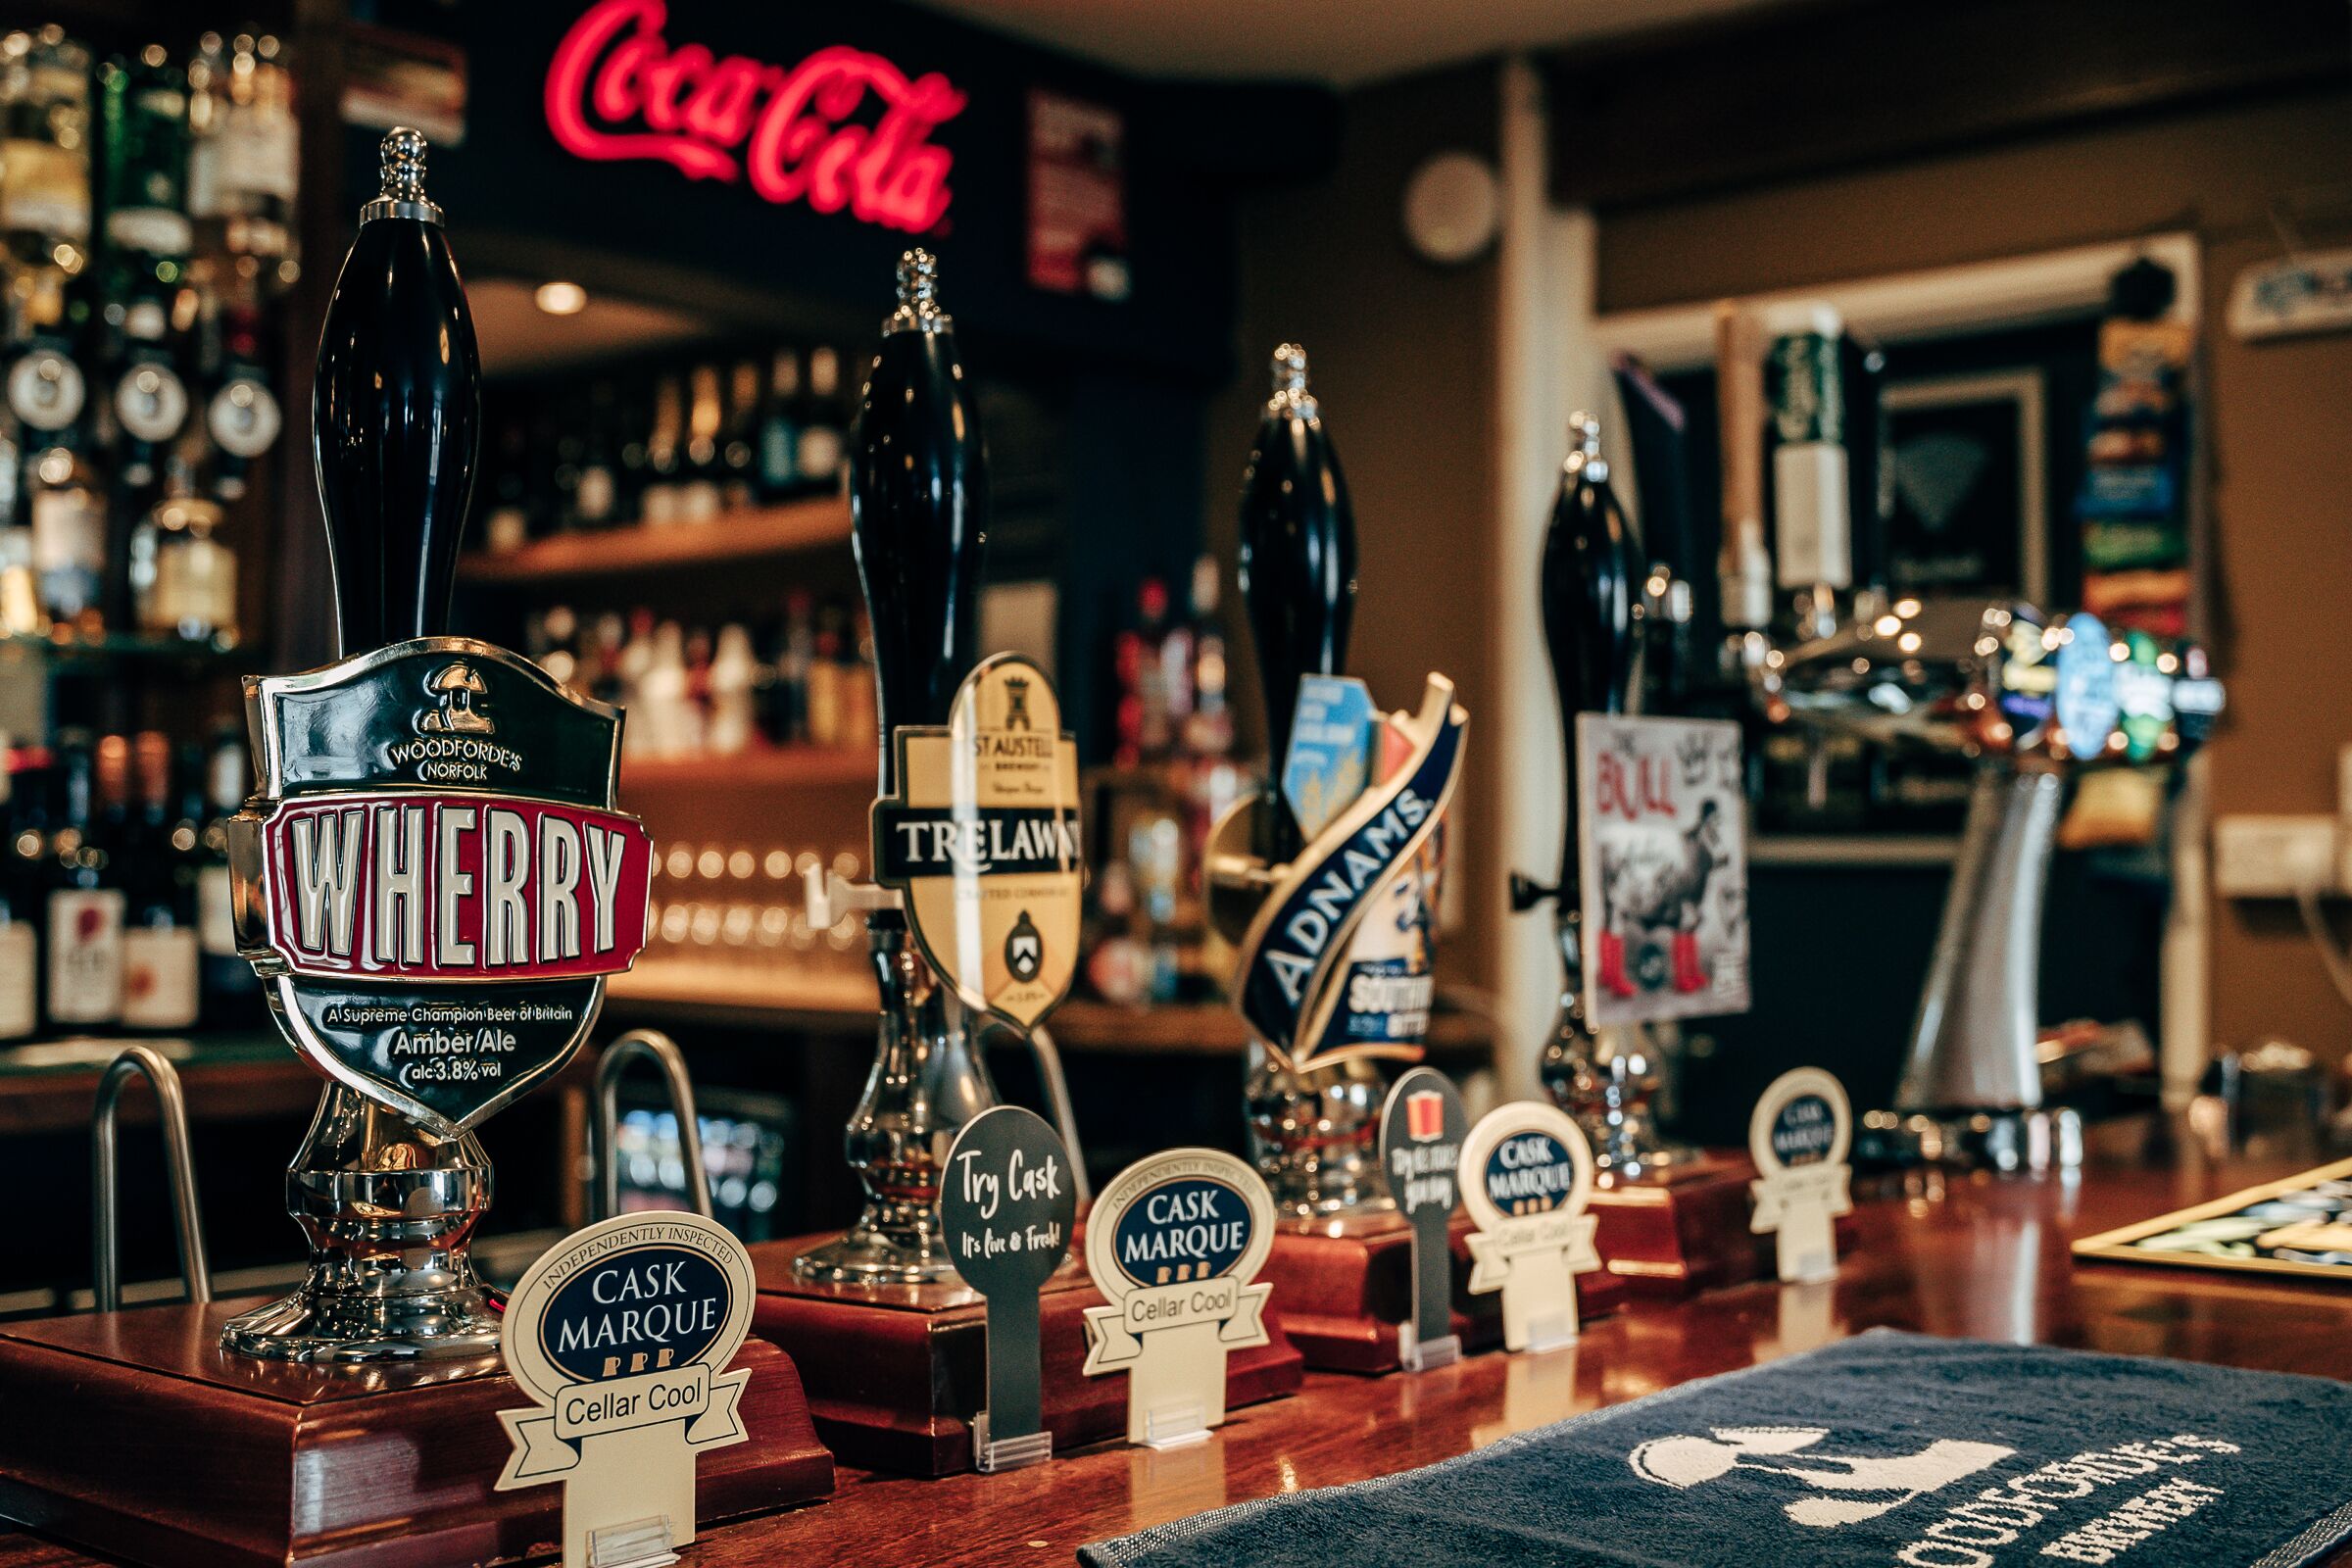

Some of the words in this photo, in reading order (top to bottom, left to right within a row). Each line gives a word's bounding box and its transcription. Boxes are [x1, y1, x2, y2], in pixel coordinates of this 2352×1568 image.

[391, 737, 523, 772] WOODFORDE'S
[426, 762, 488, 781] NORFOLK
[1595, 751, 1678, 820] BULL
[896, 819, 1081, 874] TRELAWN
[291, 804, 629, 966] WHERRY
[327, 1007, 339, 1023] A
[344, 1006, 408, 1024] Supreme
[412, 1005, 484, 1024] Champion
[488, 1007, 516, 1021] Beer
[519, 1004, 532, 1021] of
[536, 1004, 572, 1020] Britain
[394, 1029, 471, 1054] Amber
[480, 1029, 516, 1053] Ale
[412, 1067, 431, 1079] alc
[435, 1060, 478, 1081] 3.8%
[481, 1061, 502, 1078] vol
[1499, 1137, 1554, 1168] CASK
[956, 1150, 1000, 1220] Try
[1008, 1149, 1060, 1201] Cask
[1489, 1162, 1571, 1199] MARQUE
[1147, 1190, 1220, 1225] CASK
[543, 1227, 665, 1290] INDEPENDENTLY
[668, 1227, 733, 1265] INSPECTED
[1125, 1221, 1244, 1263] MARQUE
[592, 1261, 687, 1304] CASK
[558, 1298, 717, 1353] MARQUE
[1131, 1298, 1185, 1322] Cellar
[1190, 1288, 1232, 1313] Cool
[565, 1393, 640, 1425] Cellar
[649, 1377, 702, 1411] Cool
[1897, 1435, 2241, 1568] OODFORDE'S
